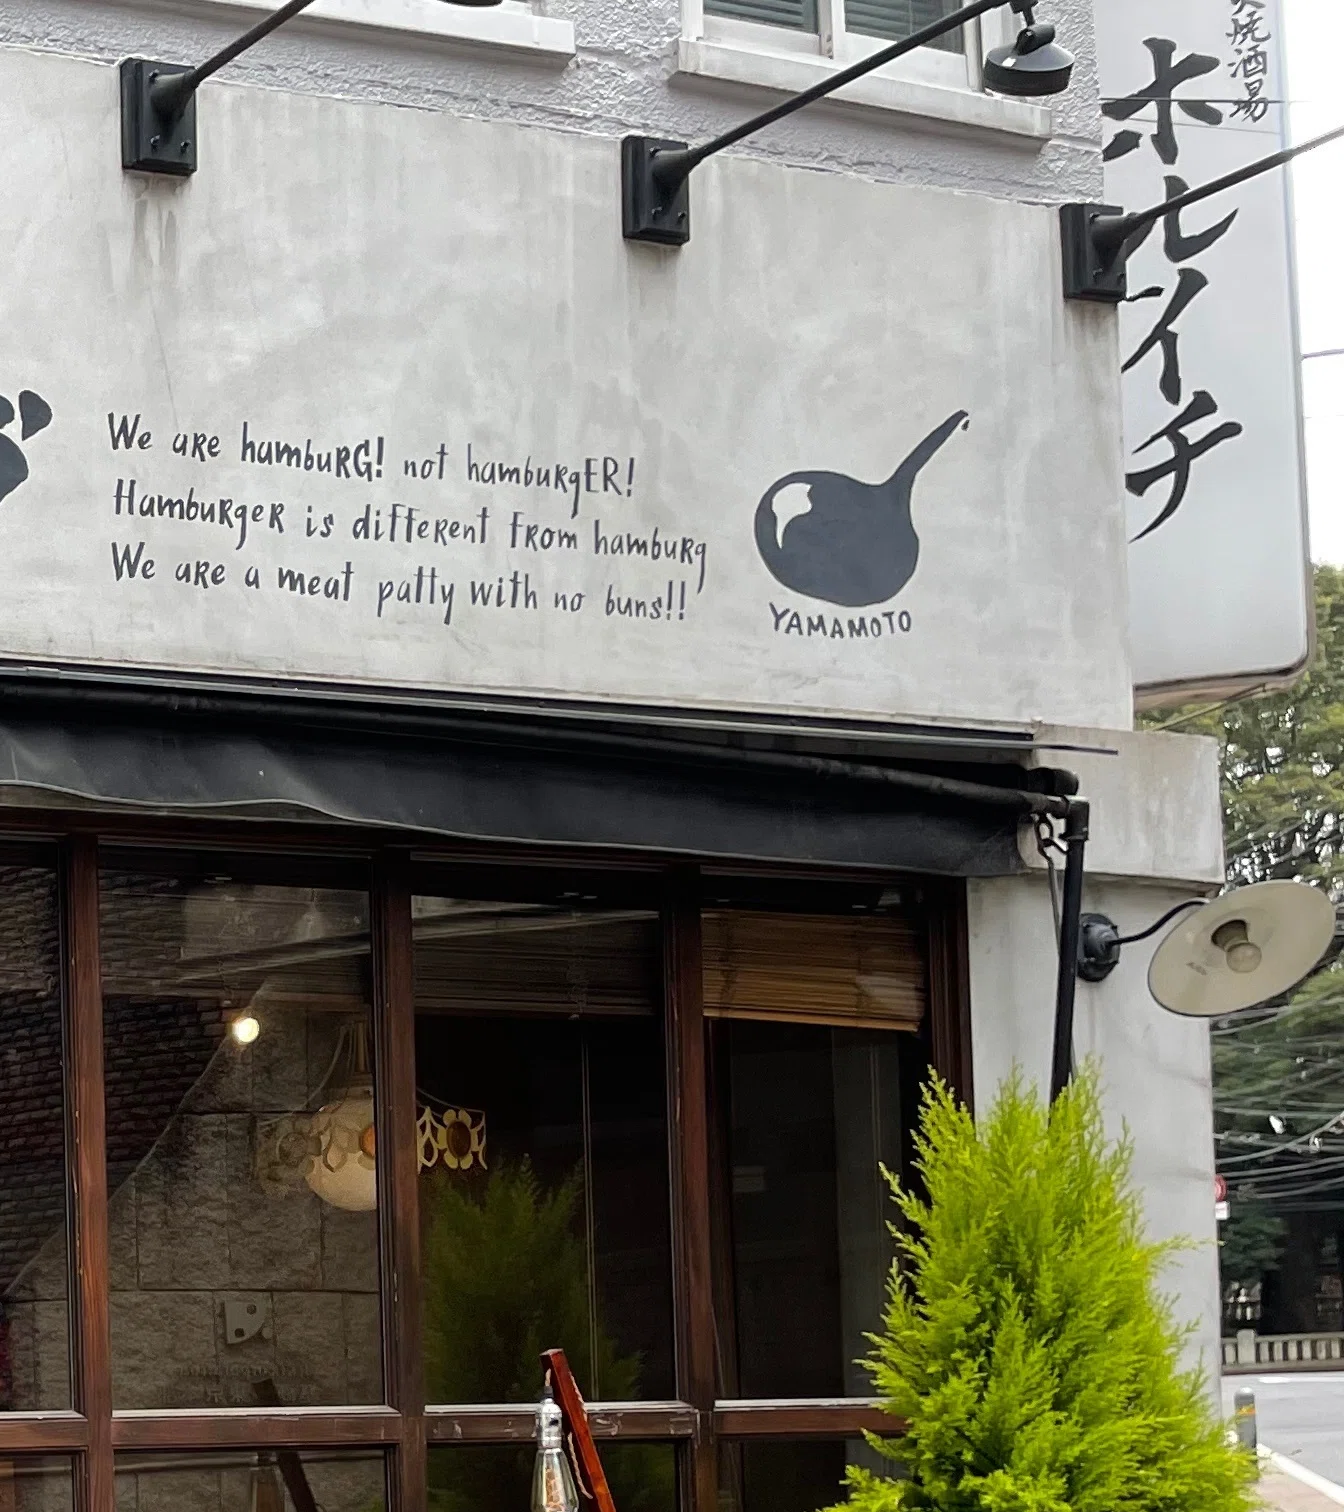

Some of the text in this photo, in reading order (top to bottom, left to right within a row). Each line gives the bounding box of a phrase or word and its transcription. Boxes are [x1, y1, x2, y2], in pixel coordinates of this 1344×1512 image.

[107, 412, 152, 451] We
[404, 443, 447, 480] not
[306, 505, 334, 538] is
[111, 541, 155, 581] We
[244, 566, 260, 589] a
[278, 561, 352, 601] meat
[377, 572, 454, 626] patty
[471, 570, 537, 609] with
[554, 592, 583, 612] no
[605, 581, 685, 621] buns!!
[769, 602, 911, 639] YAMAMOTO
